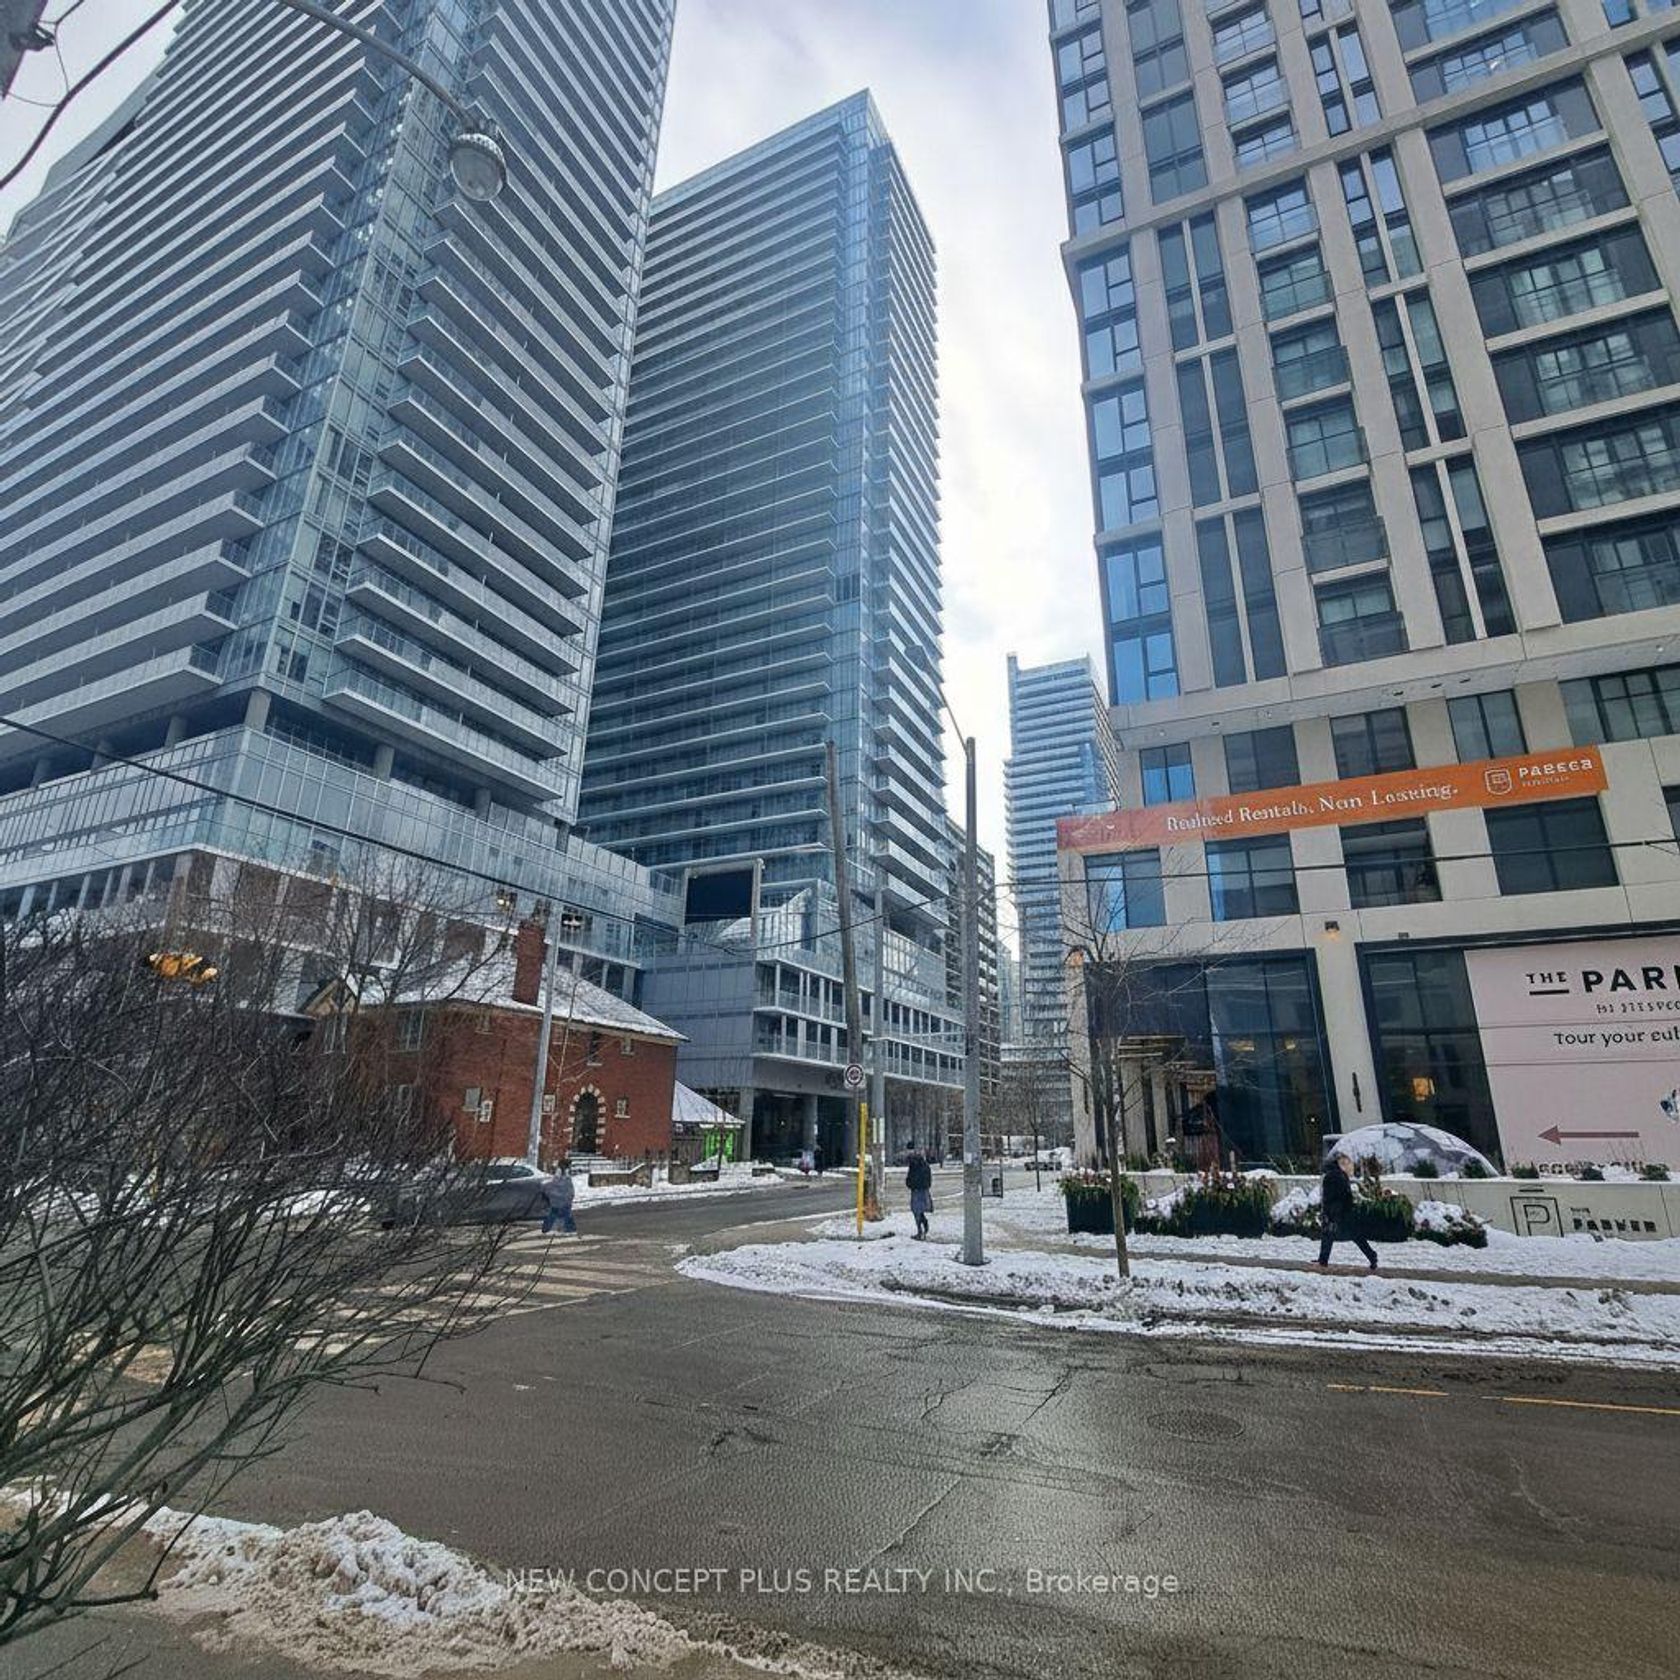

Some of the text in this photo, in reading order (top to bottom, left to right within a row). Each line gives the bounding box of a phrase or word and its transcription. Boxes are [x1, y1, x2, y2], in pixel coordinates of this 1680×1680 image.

[1526, 964, 1680, 993] THE PAR
[1554, 1032, 1596, 1045] Tour
[1601, 1030, 1646, 1048] your
